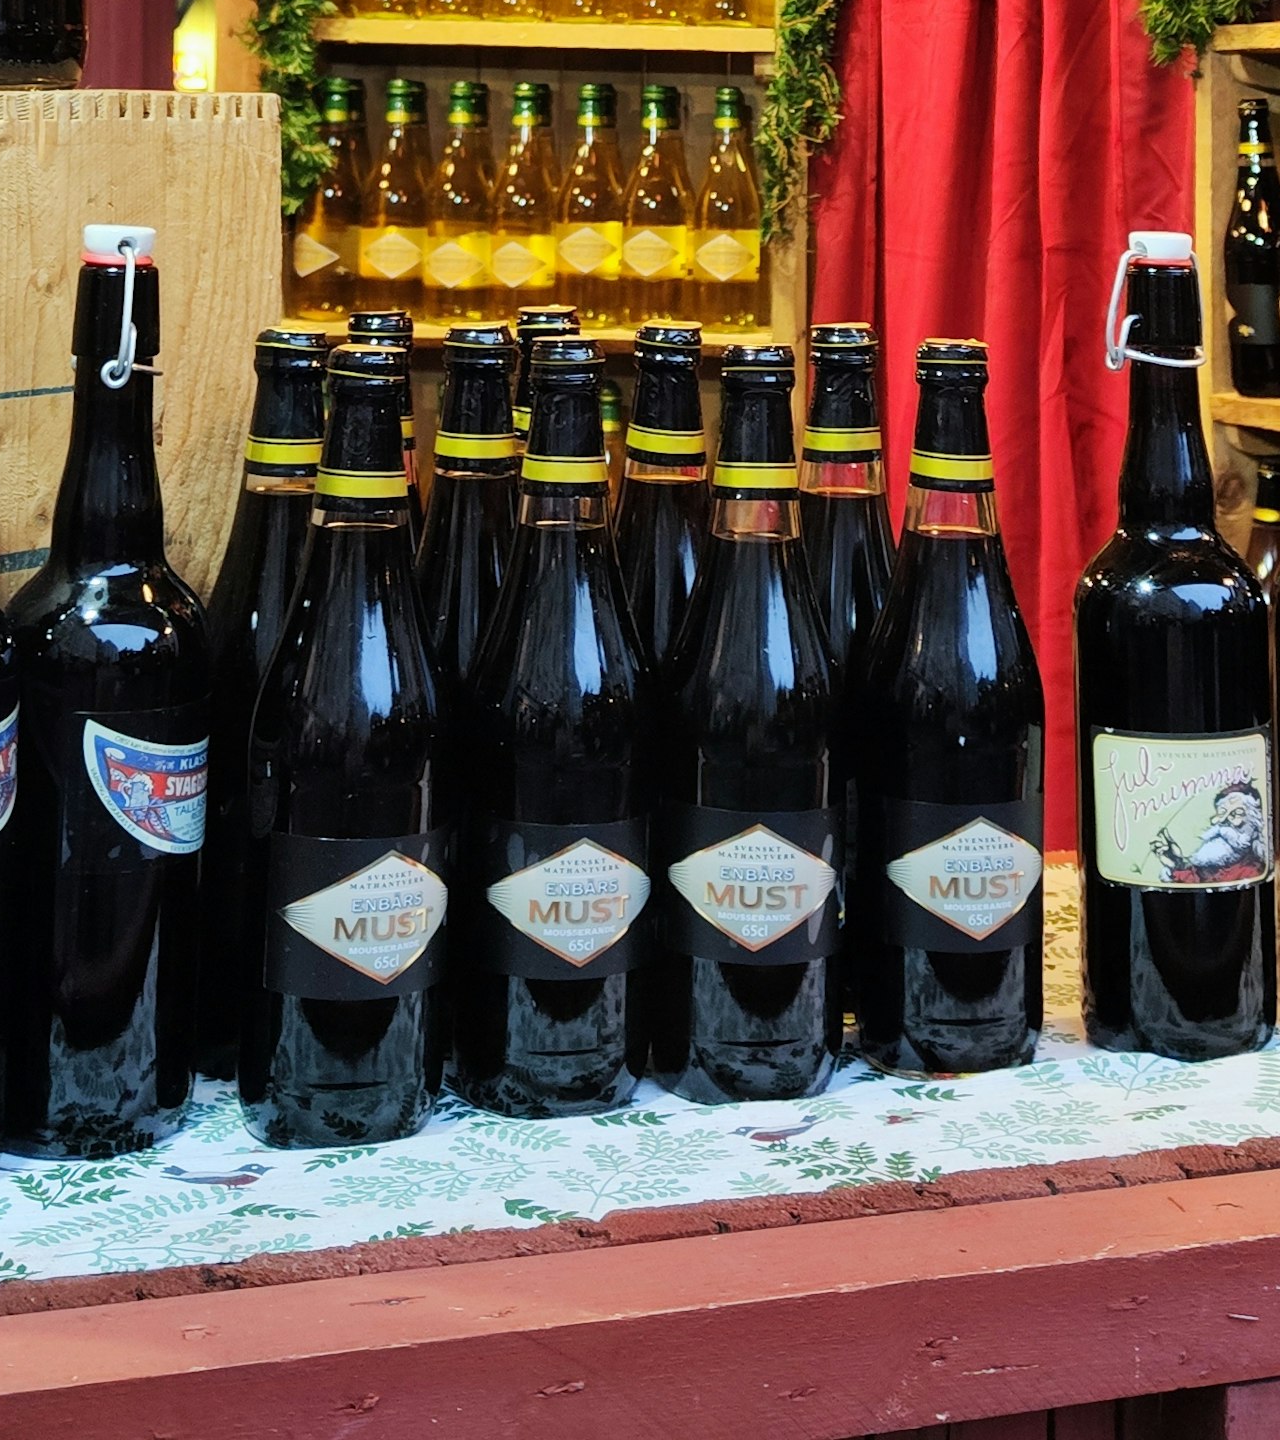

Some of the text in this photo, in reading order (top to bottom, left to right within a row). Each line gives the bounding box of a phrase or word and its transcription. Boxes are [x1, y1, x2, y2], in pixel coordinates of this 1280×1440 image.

[959, 835, 1003, 844] SVENSKT
[734, 845, 782, 853] SVENSKT
[560, 857, 606, 867] SVENSKT
[943, 855, 1015, 874] ENBÄRS
[367, 870, 413, 883] SVENSKT
[720, 865, 796, 883] ENBÄRS
[545, 877, 620, 897] ENBÄRS
[929, 870, 1025, 900] MUST
[351, 891, 423, 914] ENBÄRS
[703, 881, 809, 911] MUST
[528, 893, 631, 925] MUST
[333, 906, 434, 943] MUST
[967, 913, 994, 926] 65cl
[741, 924, 769, 938] 65cl
[568, 938, 595, 953] 65cl
[373, 954, 400, 971] 65cl
